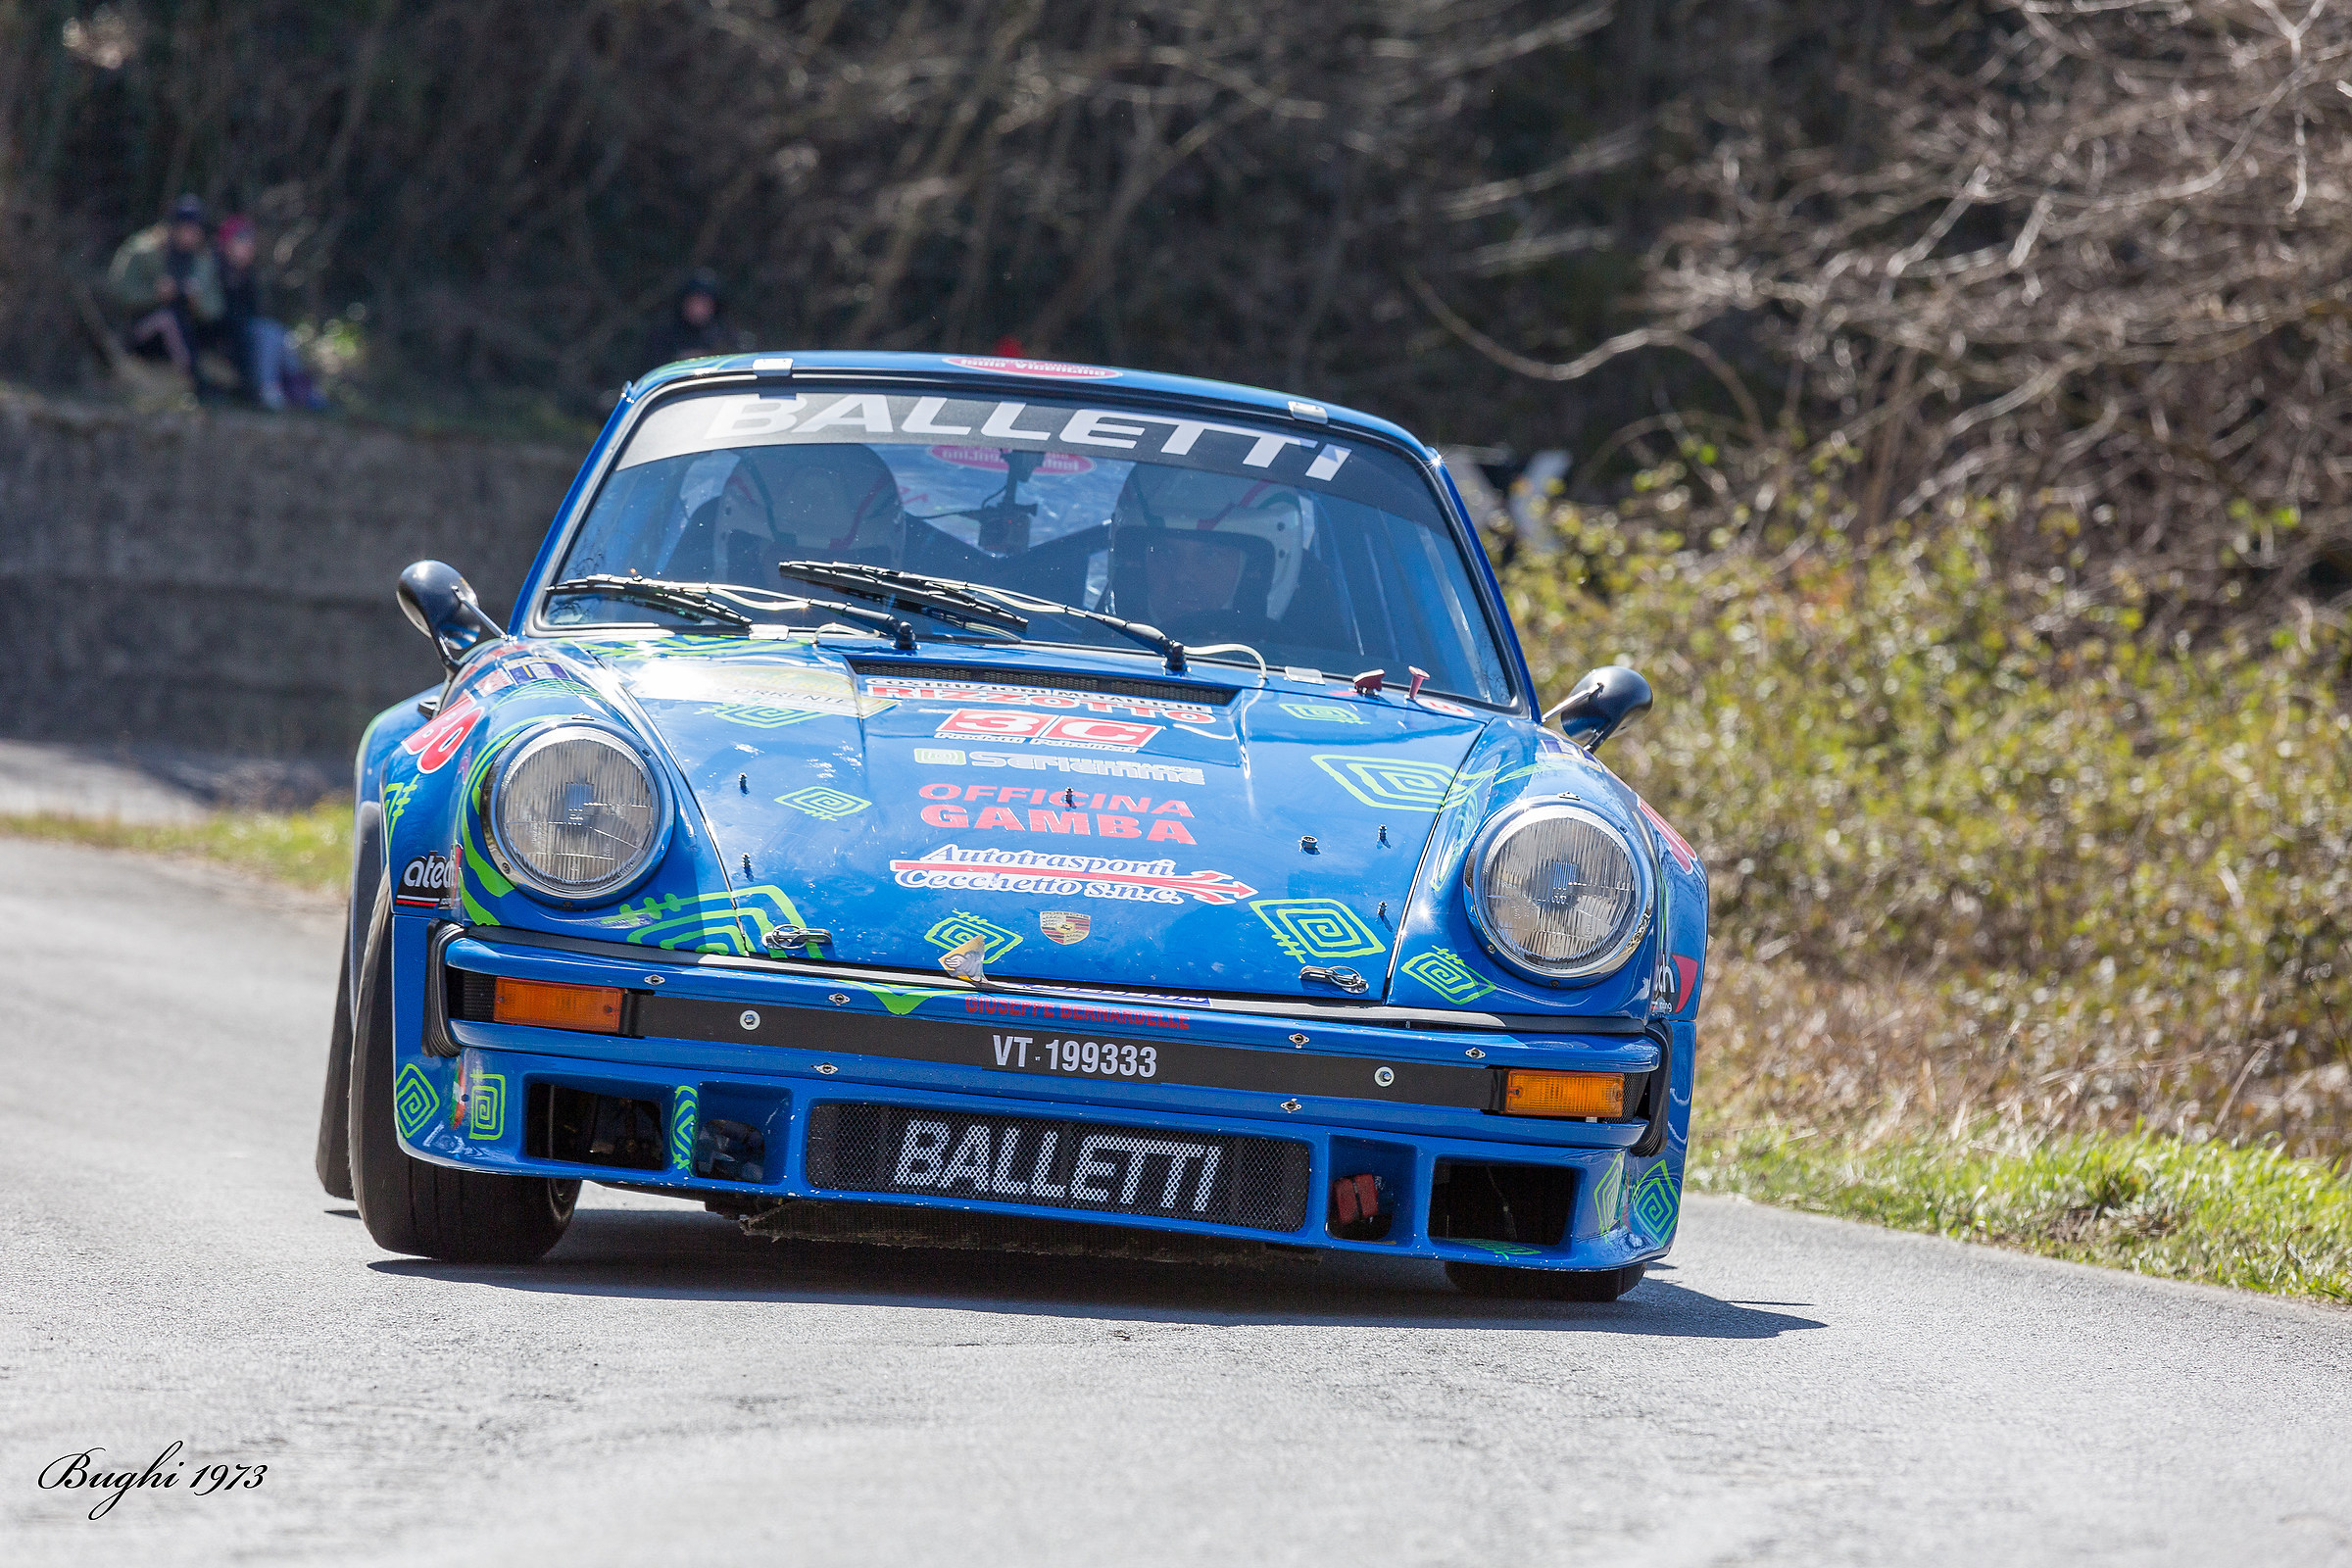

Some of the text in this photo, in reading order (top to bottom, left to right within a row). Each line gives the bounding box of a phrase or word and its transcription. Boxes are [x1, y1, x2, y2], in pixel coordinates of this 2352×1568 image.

[705, 393, 1351, 481] BALLETTI
[867, 684, 1216, 723] RIZZOTTO
[949, 711, 1153, 745] 3C
[918, 783, 1195, 818] OFFICINA
[920, 804, 1198, 845] GAMBA
[924, 845, 1174, 877] Autotrasporti
[900, 868, 1181, 903] Cecchetto s.n.c.
[965, 996, 1190, 1029] GIUSEPPE BERNARDELLE
[992, 1034, 1157, 1078] VT 199333
[894, 1120, 1222, 1212] BALLETTI
